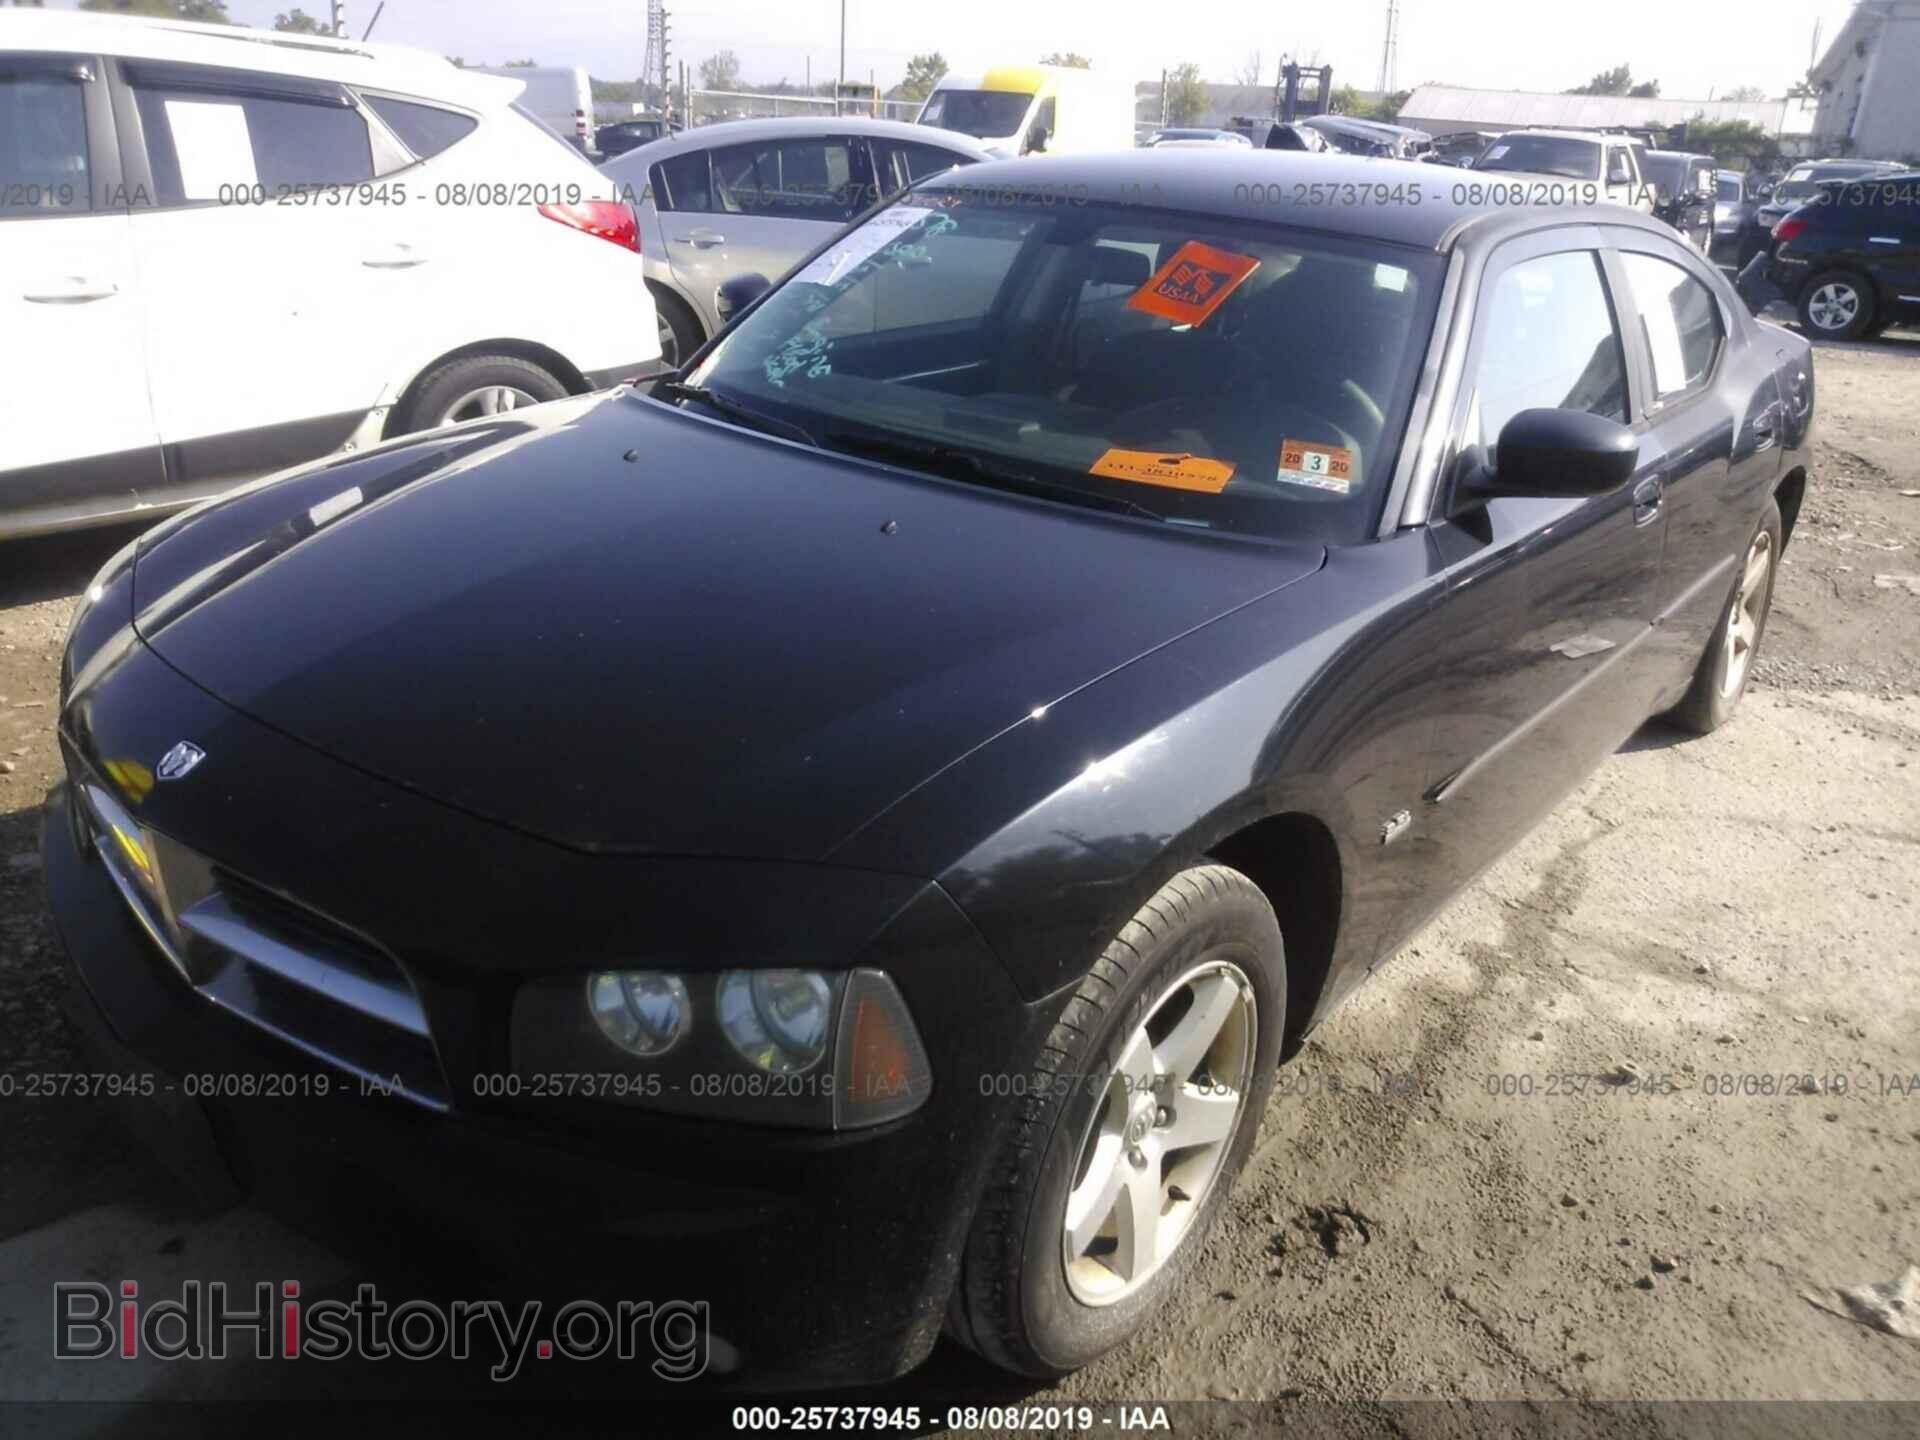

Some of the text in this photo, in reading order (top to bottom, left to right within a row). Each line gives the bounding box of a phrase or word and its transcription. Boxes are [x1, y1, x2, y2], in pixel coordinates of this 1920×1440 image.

[1285, 453, 1349, 472] 20 3 20
